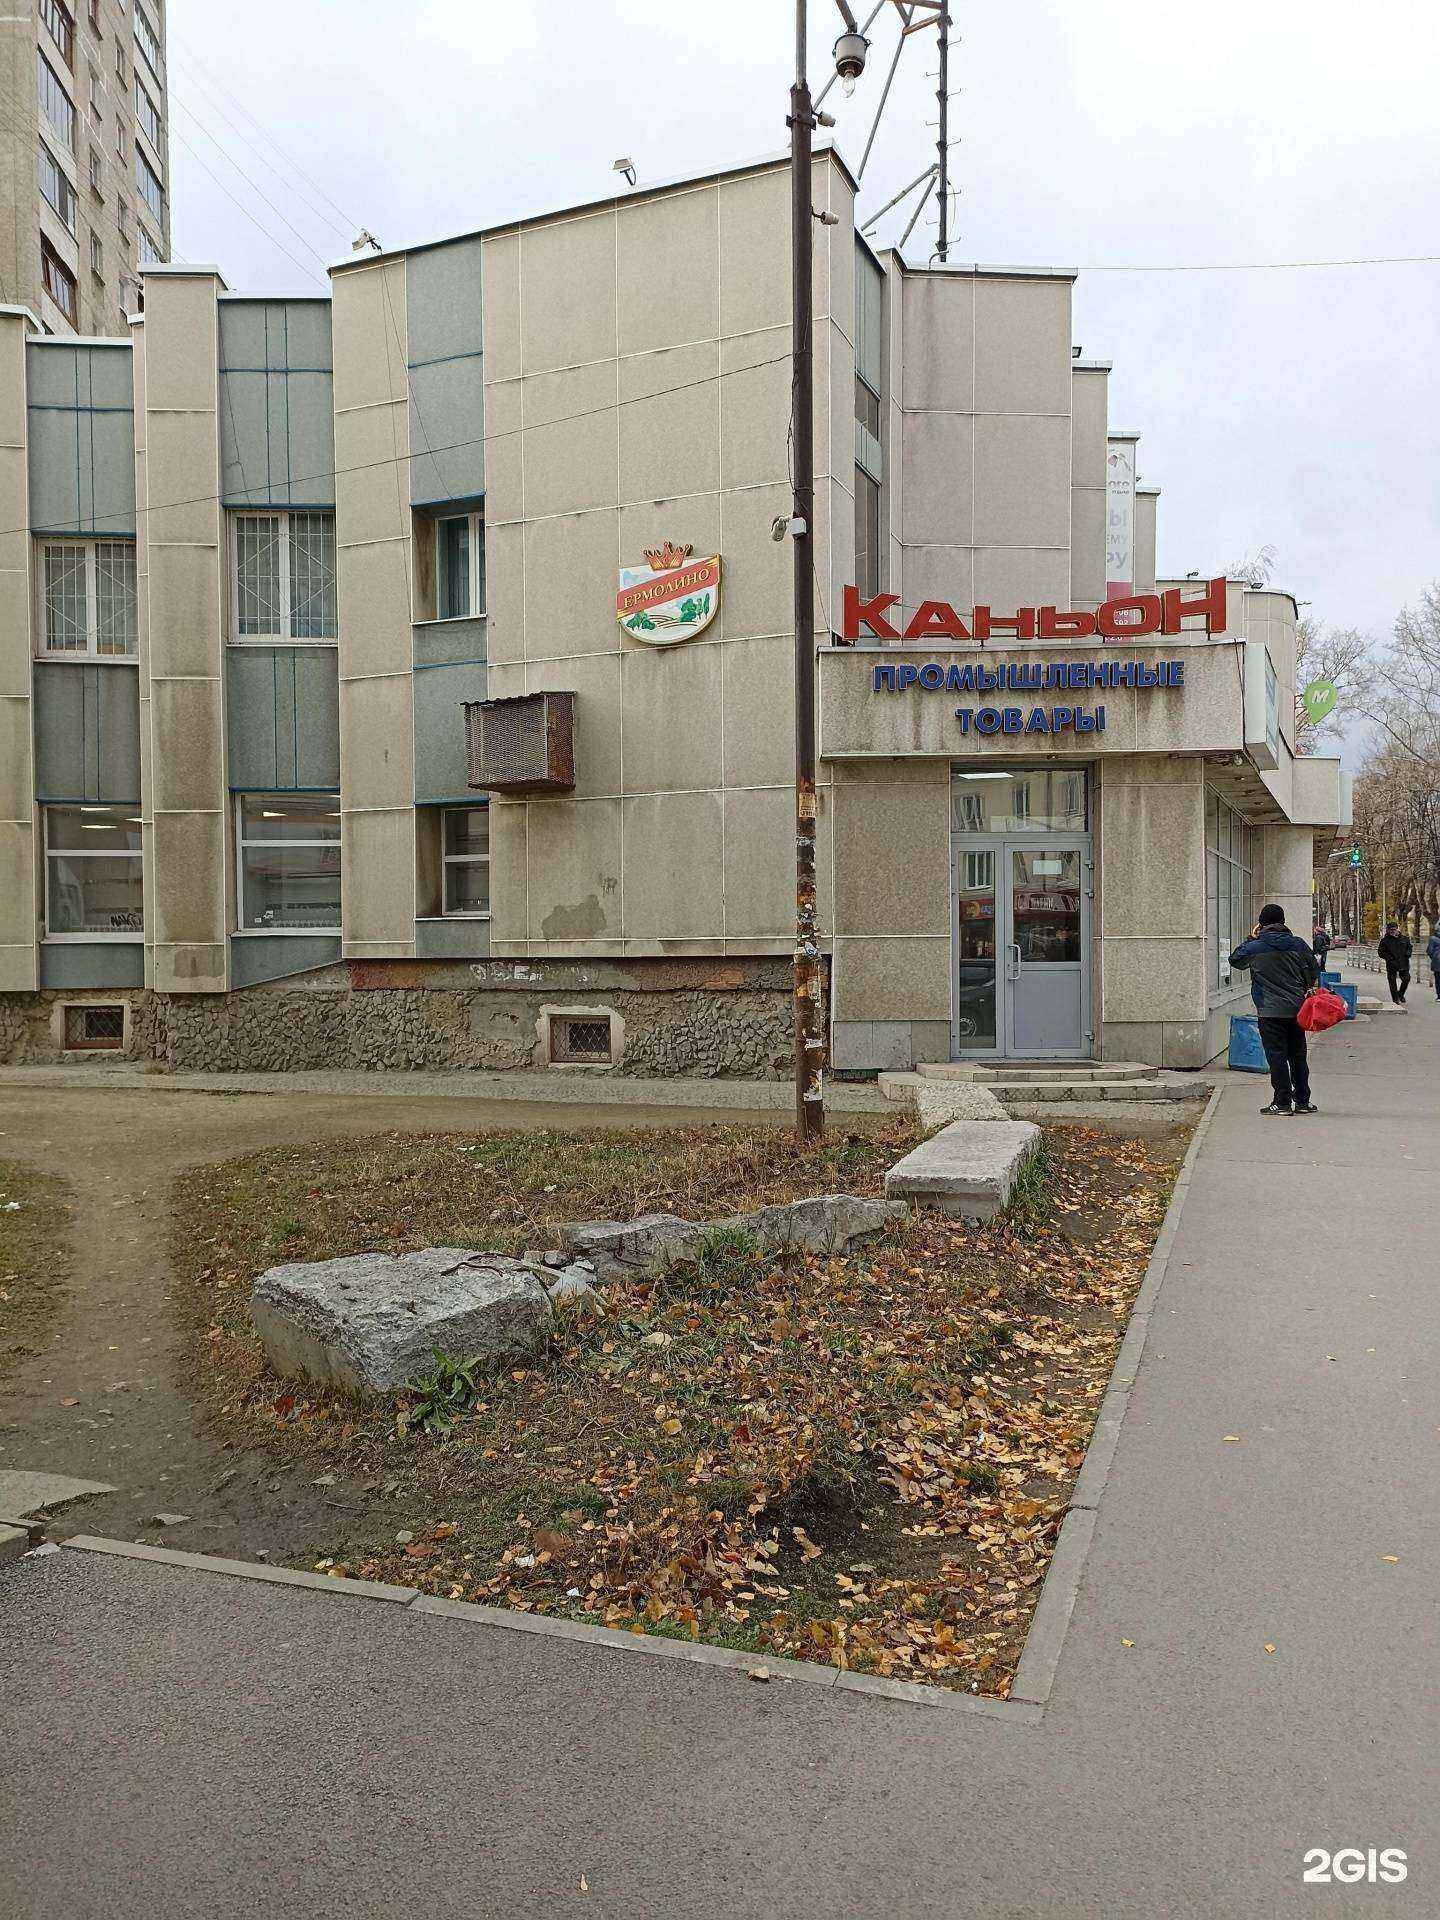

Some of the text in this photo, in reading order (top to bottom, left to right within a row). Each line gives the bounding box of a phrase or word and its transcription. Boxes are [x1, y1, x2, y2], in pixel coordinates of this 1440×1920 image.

[623, 568, 710, 609] ЕРМОЛИНО
[841, 576, 1227, 641] КАНЬОН
[873, 660, 1186, 692] ПРОМЫШЛЕННЫЕ
[955, 705, 1107, 734] ТОВАРЫ
